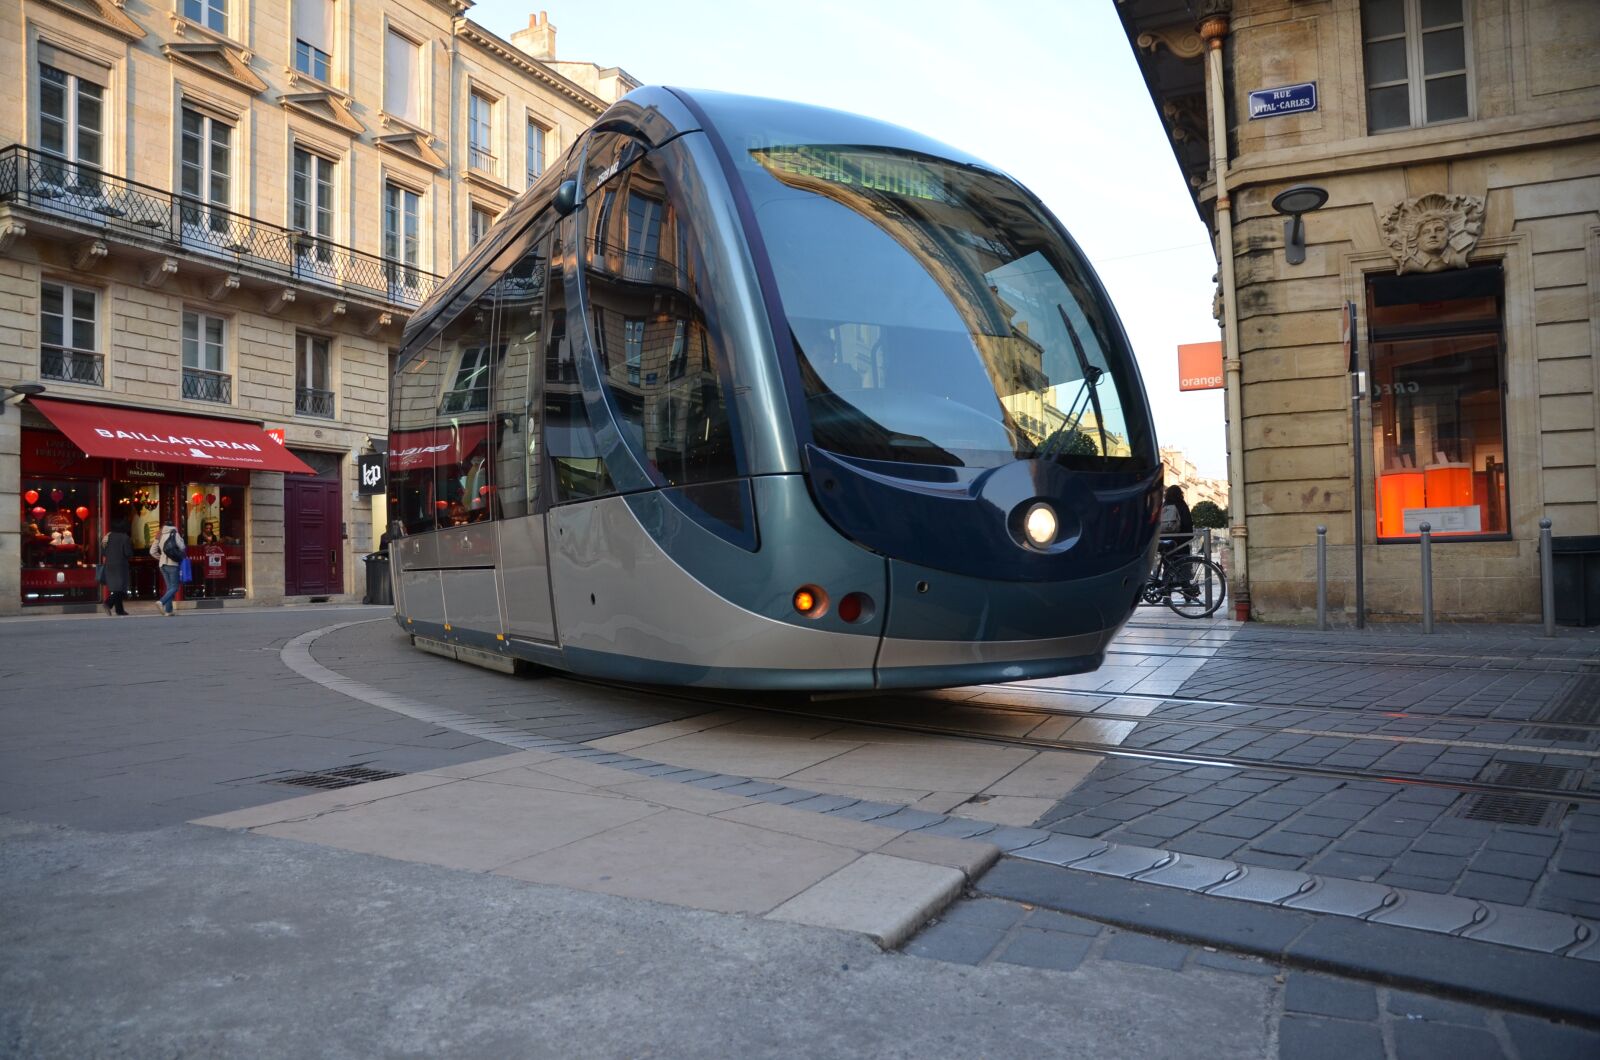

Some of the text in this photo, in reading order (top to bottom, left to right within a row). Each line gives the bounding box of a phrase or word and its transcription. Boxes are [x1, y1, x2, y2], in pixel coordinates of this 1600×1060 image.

[1273, 90, 1291, 99] RUE
[1254, 98, 1310, 113] VITAL-CARLES
[861, 157, 933, 201] CENTRE
[1181, 376, 1222, 387] orange
[94, 428, 262, 452] BAILLARDRAN
